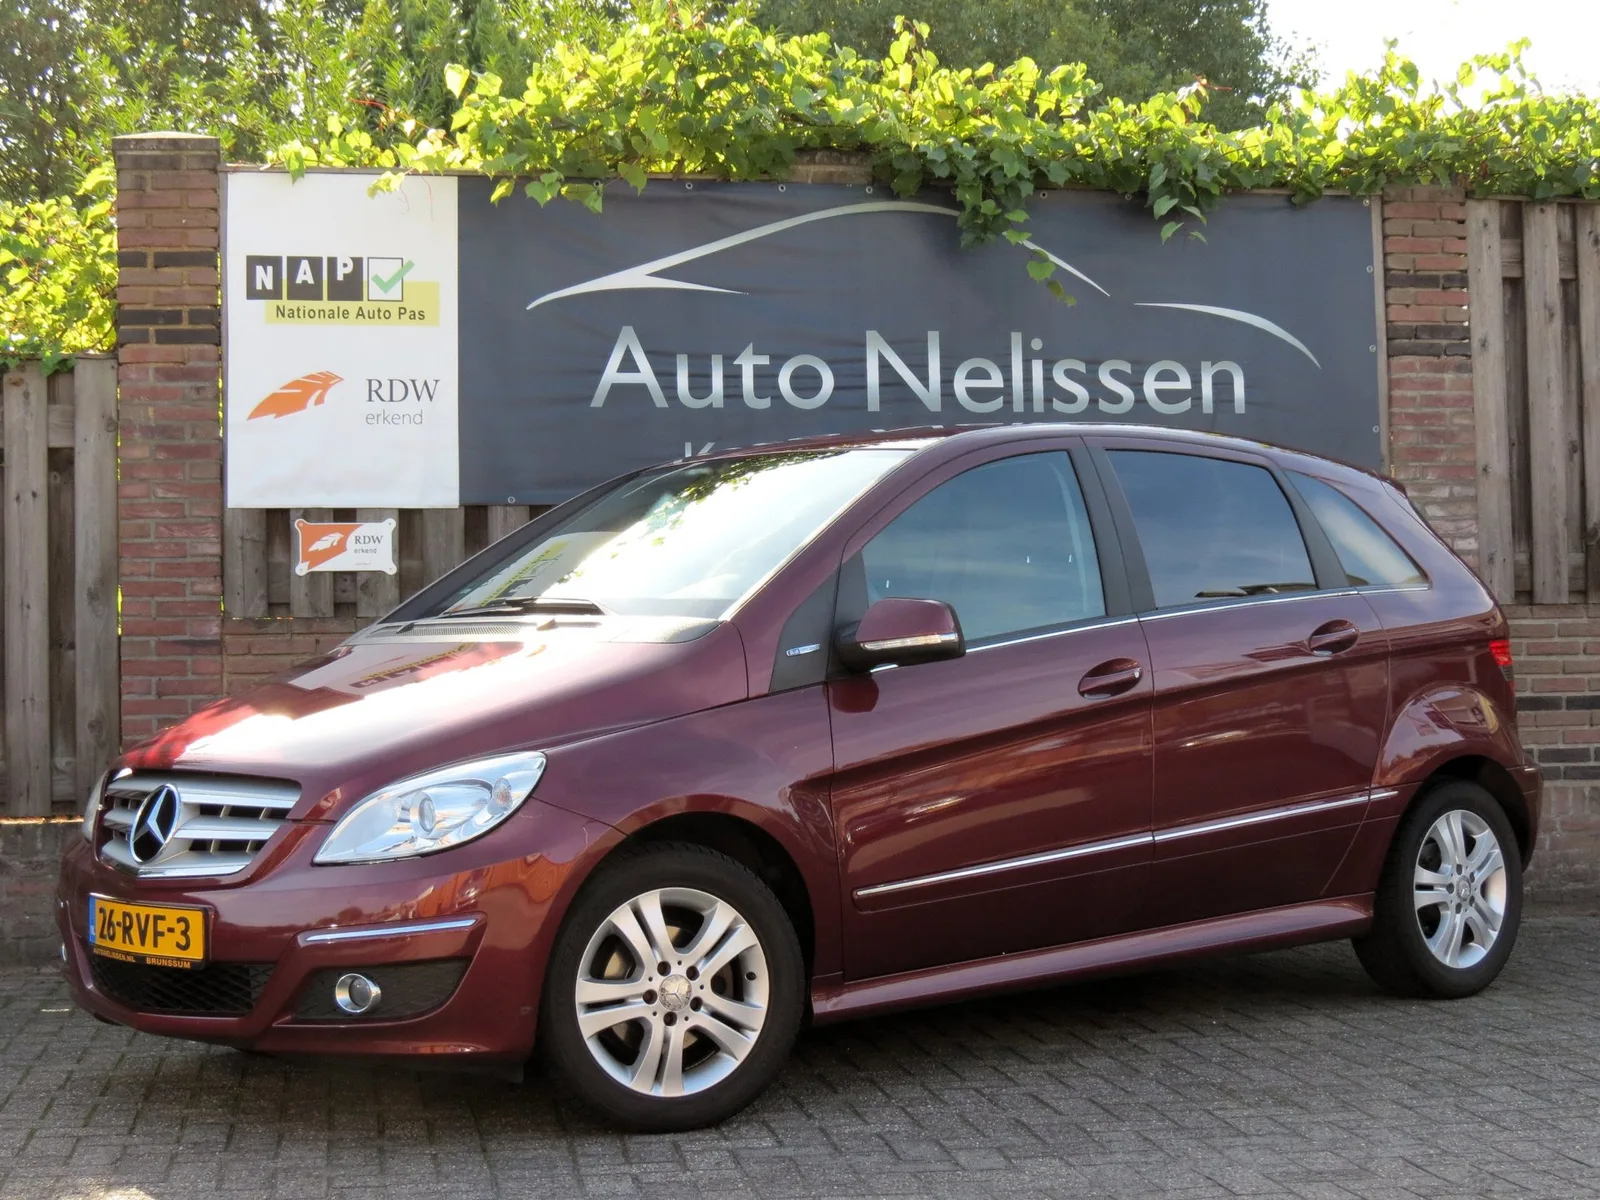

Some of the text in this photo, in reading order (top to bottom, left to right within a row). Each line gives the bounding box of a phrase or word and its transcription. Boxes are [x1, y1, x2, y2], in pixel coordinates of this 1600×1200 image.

[255, 255, 354, 291] NAP
[275, 305, 426, 321] Nationale Auto Pas
[590, 325, 1247, 415] Auto Nelissen
[366, 378, 441, 403] RDW
[365, 409, 424, 426] erkend
[354, 535, 384, 545] RDW
[98, 906, 191, 952] 26-RVF-3
[146, 957, 191, 969] BRUNSSUM
